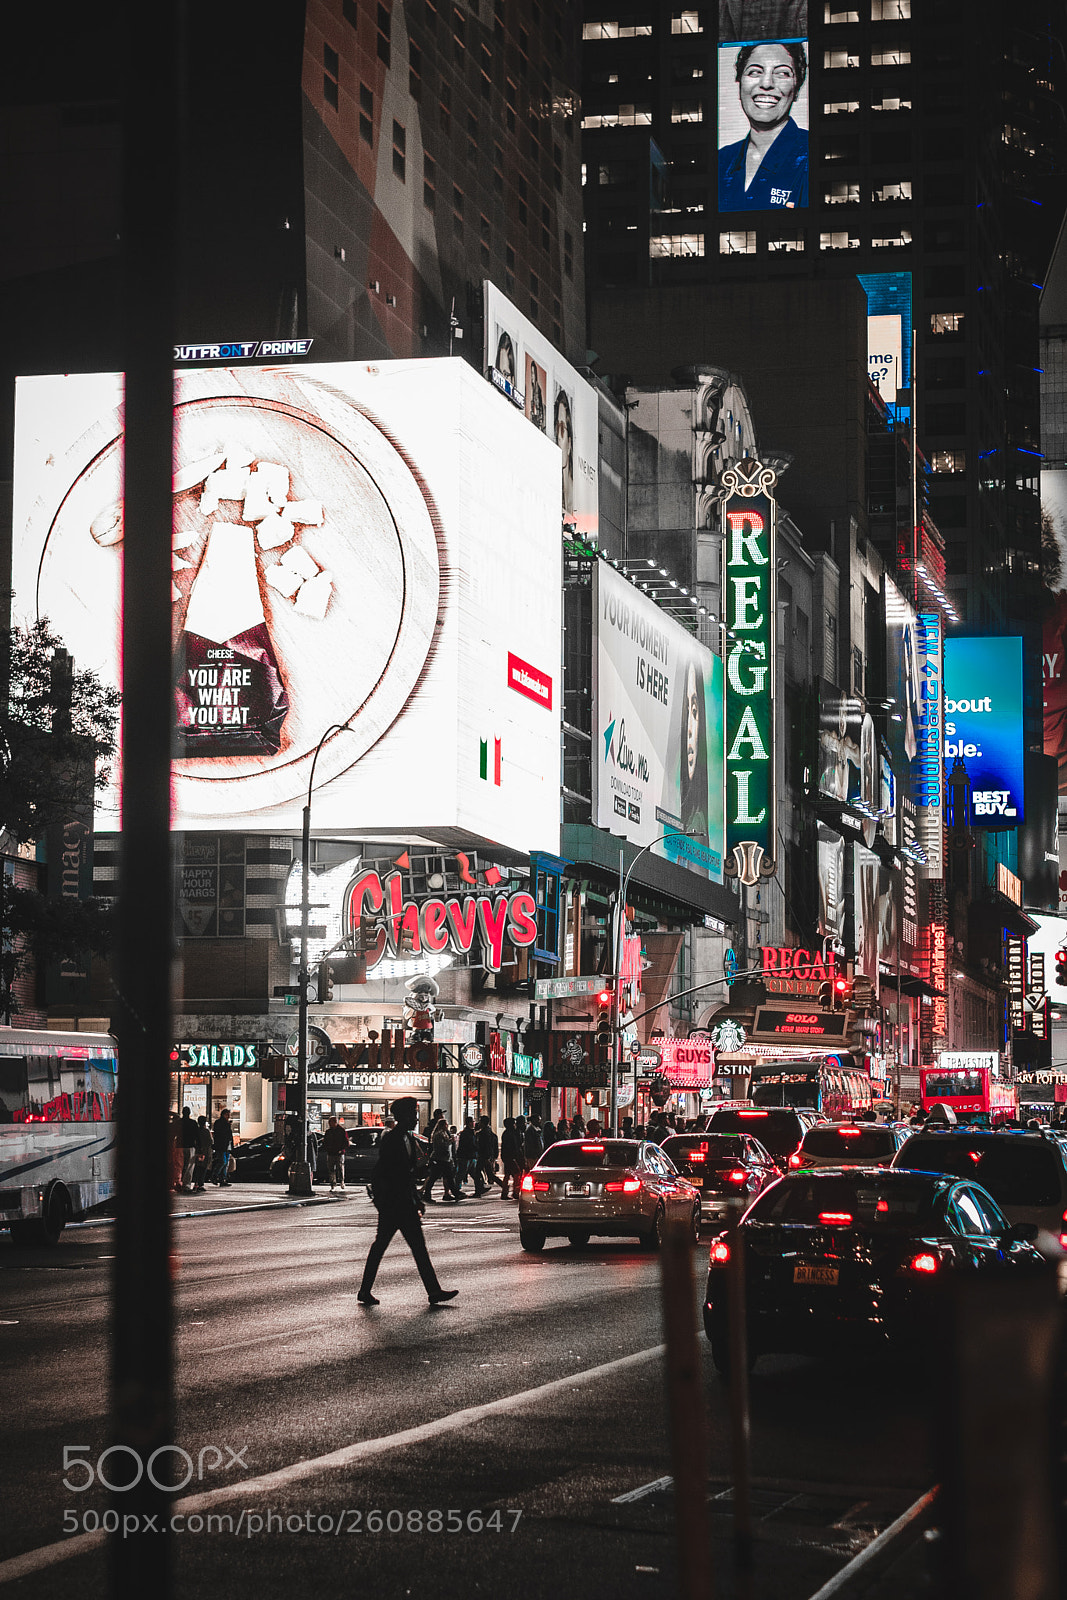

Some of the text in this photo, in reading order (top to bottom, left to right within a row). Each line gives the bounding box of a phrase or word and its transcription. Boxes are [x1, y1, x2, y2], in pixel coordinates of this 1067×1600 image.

[770, 196, 788, 205] BUY
[771, 188, 792, 199] BEST
[262, 342, 307, 354] PRIME
[867, 367, 888, 381] e?
[603, 589, 669, 665] YOUR MOMENT
[921, 613, 939, 656] NEW
[207, 649, 234, 659] CHEESE
[726, 511, 769, 824] REGAL
[188, 668, 252, 687] YOU ARE
[636, 656, 669, 706] IS HERE
[198, 687, 241, 706] WHAT
[188, 707, 250, 725] YOU EAT
[925, 728, 940, 807] STUDIOS
[972, 790, 1011, 804] BEST
[975, 803, 1006, 816] BUY
[180, 869, 214, 878] HAPPY
[183, 878, 212, 888] HOUR
[179, 888, 216, 898] MARGS
[343, 868, 538, 973] Chevys
[1009, 939, 1022, 993] VICTORY
[1031, 954, 1043, 993] CTORY
[769, 979, 820, 995] CINEM
[785, 1014, 819, 1025] SOLO
[775, 1025, 780, 1033] A
[781, 1025, 794, 1033] STAR
[810, 1026, 825, 1035] STORY
[288, 1039, 328, 1056] vlla
[335, 1029, 440, 1069] villa
[188, 1044, 256, 1067] SALADS
[463, 1050, 483, 1060] villa
[676, 1048, 711, 1063] GUYS
[717, 1064, 752, 1075] ESTIN
[306, 1073, 430, 1087] ARKET FOOD COURT
[185, 1094, 206, 1102] Juice
